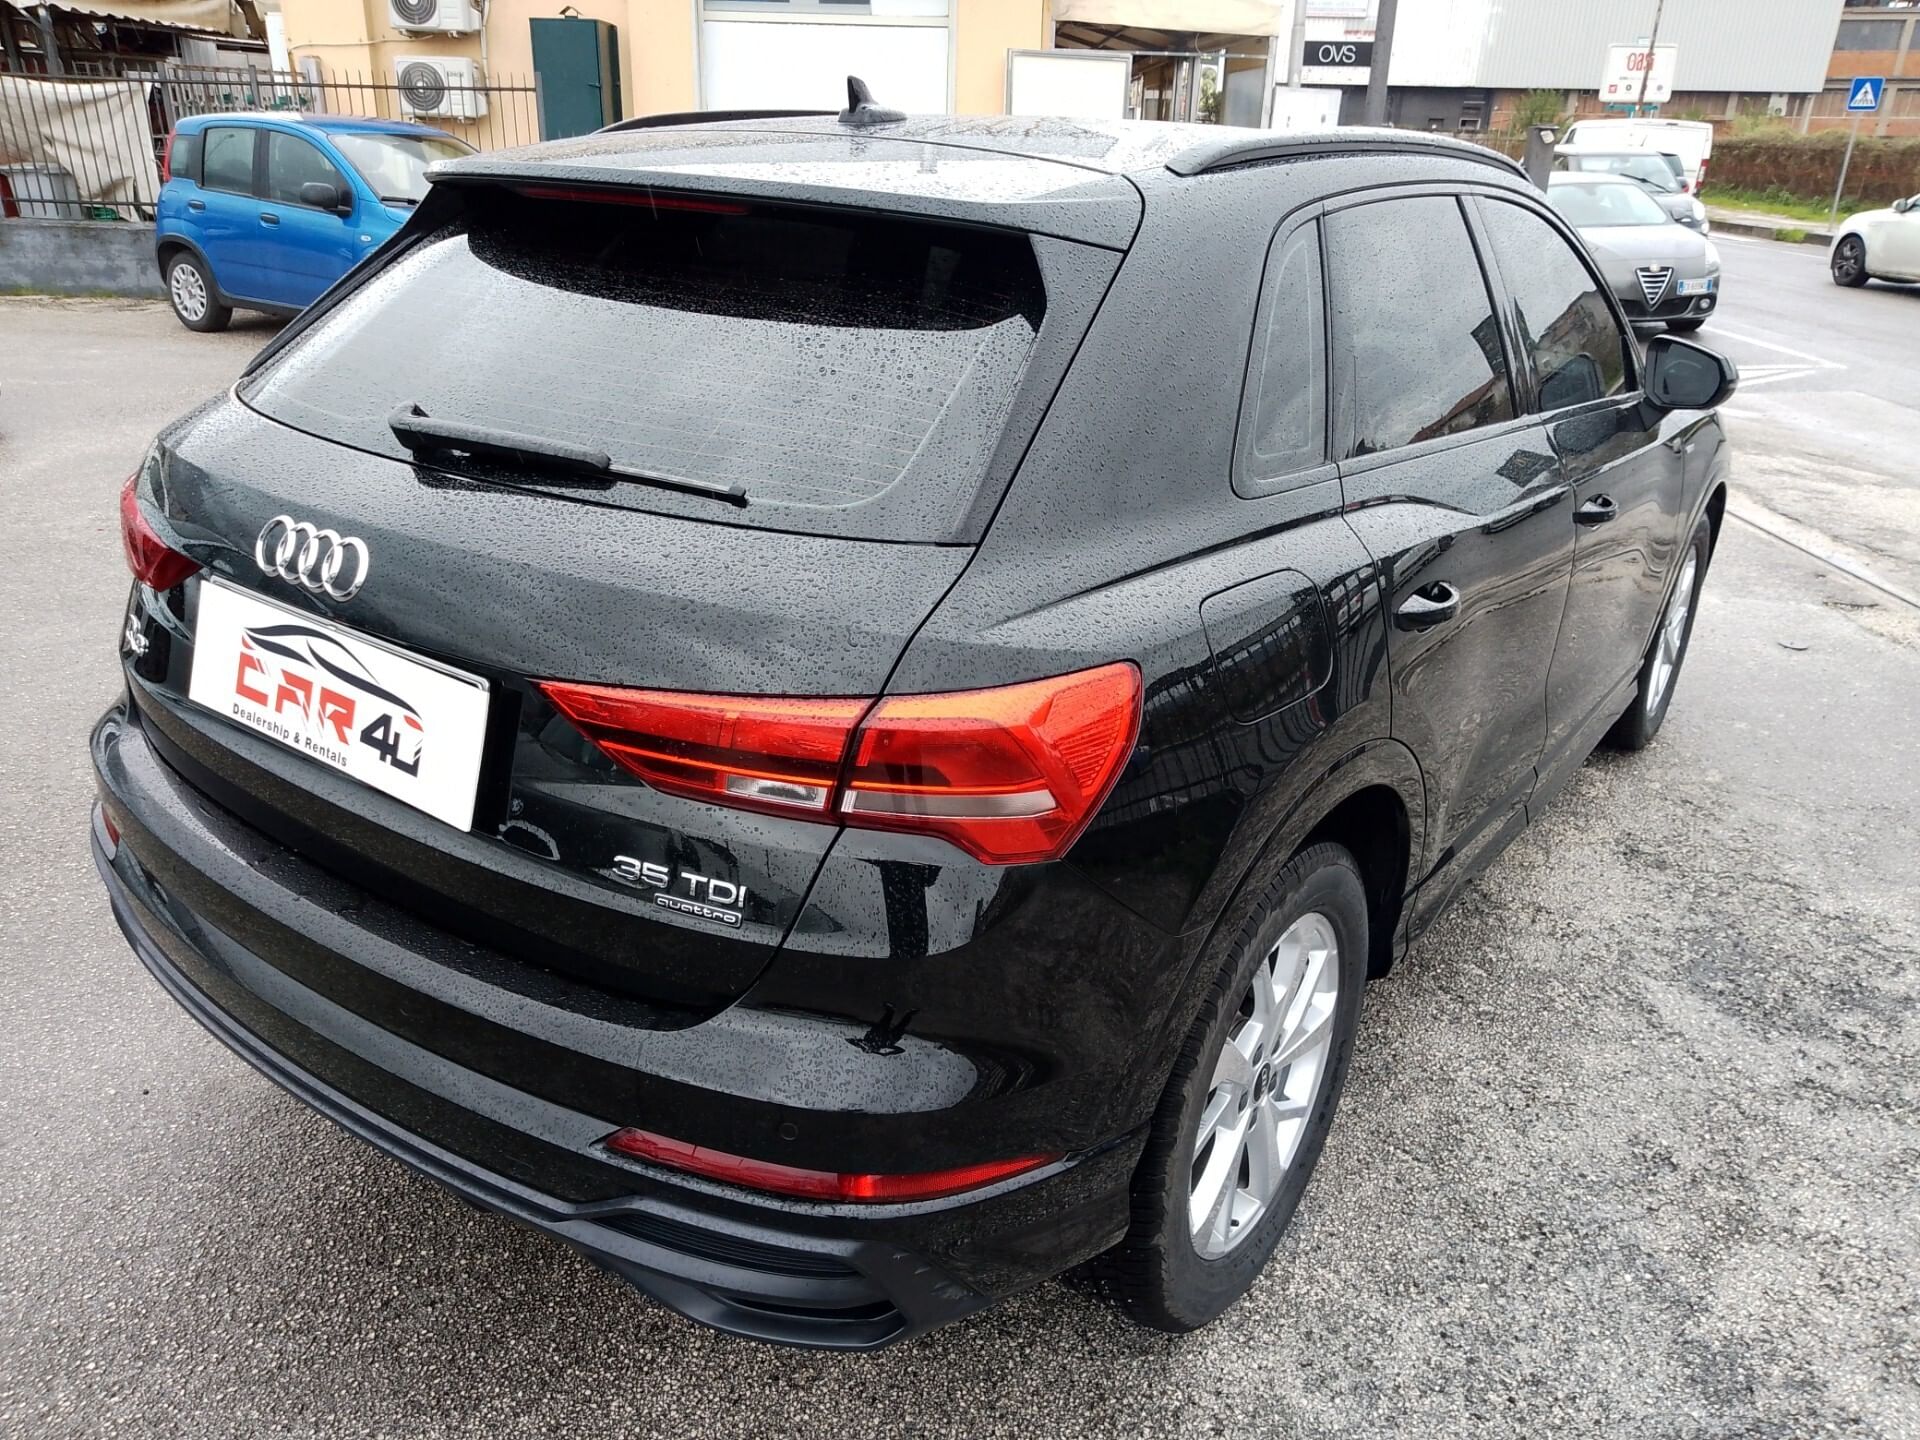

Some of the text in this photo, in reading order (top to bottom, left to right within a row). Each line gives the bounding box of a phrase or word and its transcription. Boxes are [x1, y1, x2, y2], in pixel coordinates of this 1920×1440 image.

[1318, 44, 1357, 63] OVS
[234, 651, 356, 746] CAR
[233, 703, 348, 768] Dealership & Rentals
[612, 855, 747, 908] 35 TDI
[656, 897, 736, 923] quattro
